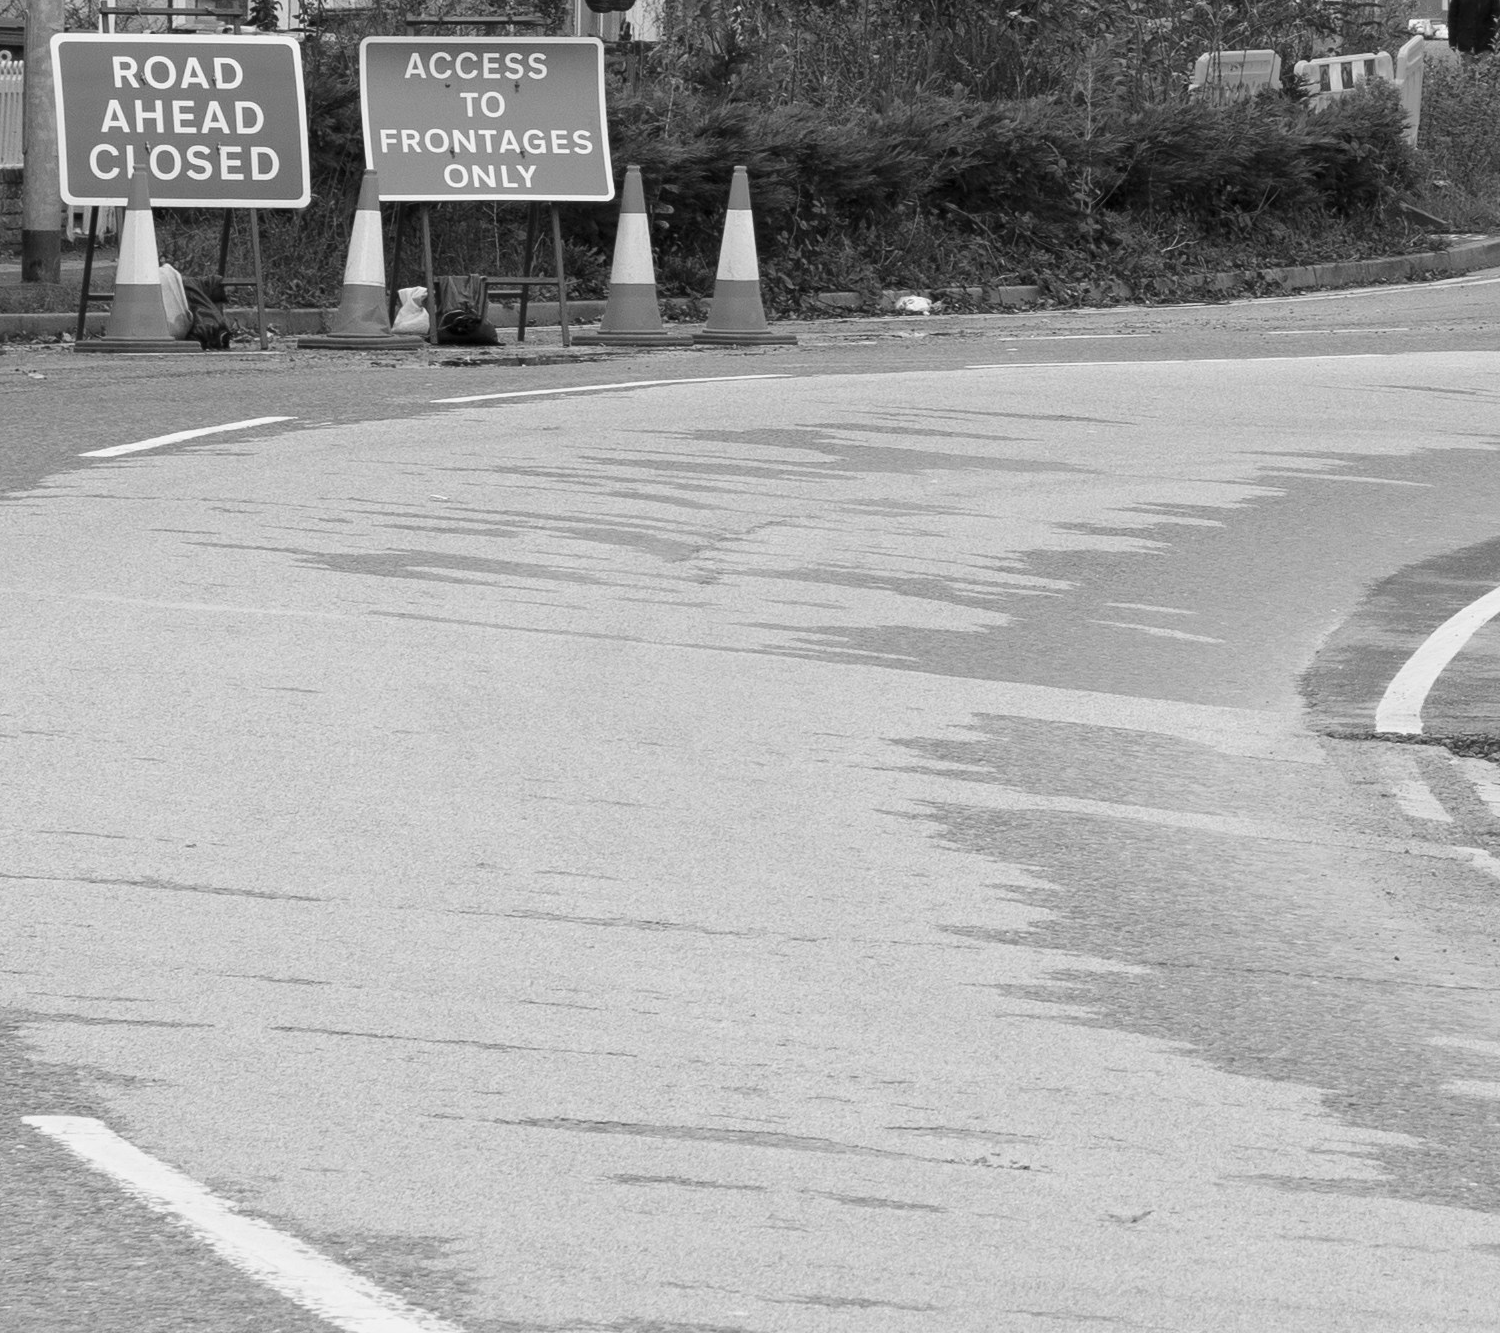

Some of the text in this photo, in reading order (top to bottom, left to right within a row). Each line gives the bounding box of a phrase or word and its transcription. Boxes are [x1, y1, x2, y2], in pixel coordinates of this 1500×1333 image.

[112, 55, 243, 90] ROAD
[404, 51, 548, 80] ACCESS
[100, 99, 265, 135] AHEAD
[459, 91, 506, 118] TO
[379, 128, 593, 155] FRONTAGES
[89, 143, 280, 181] CLOSED
[443, 163, 537, 188] ONLY
